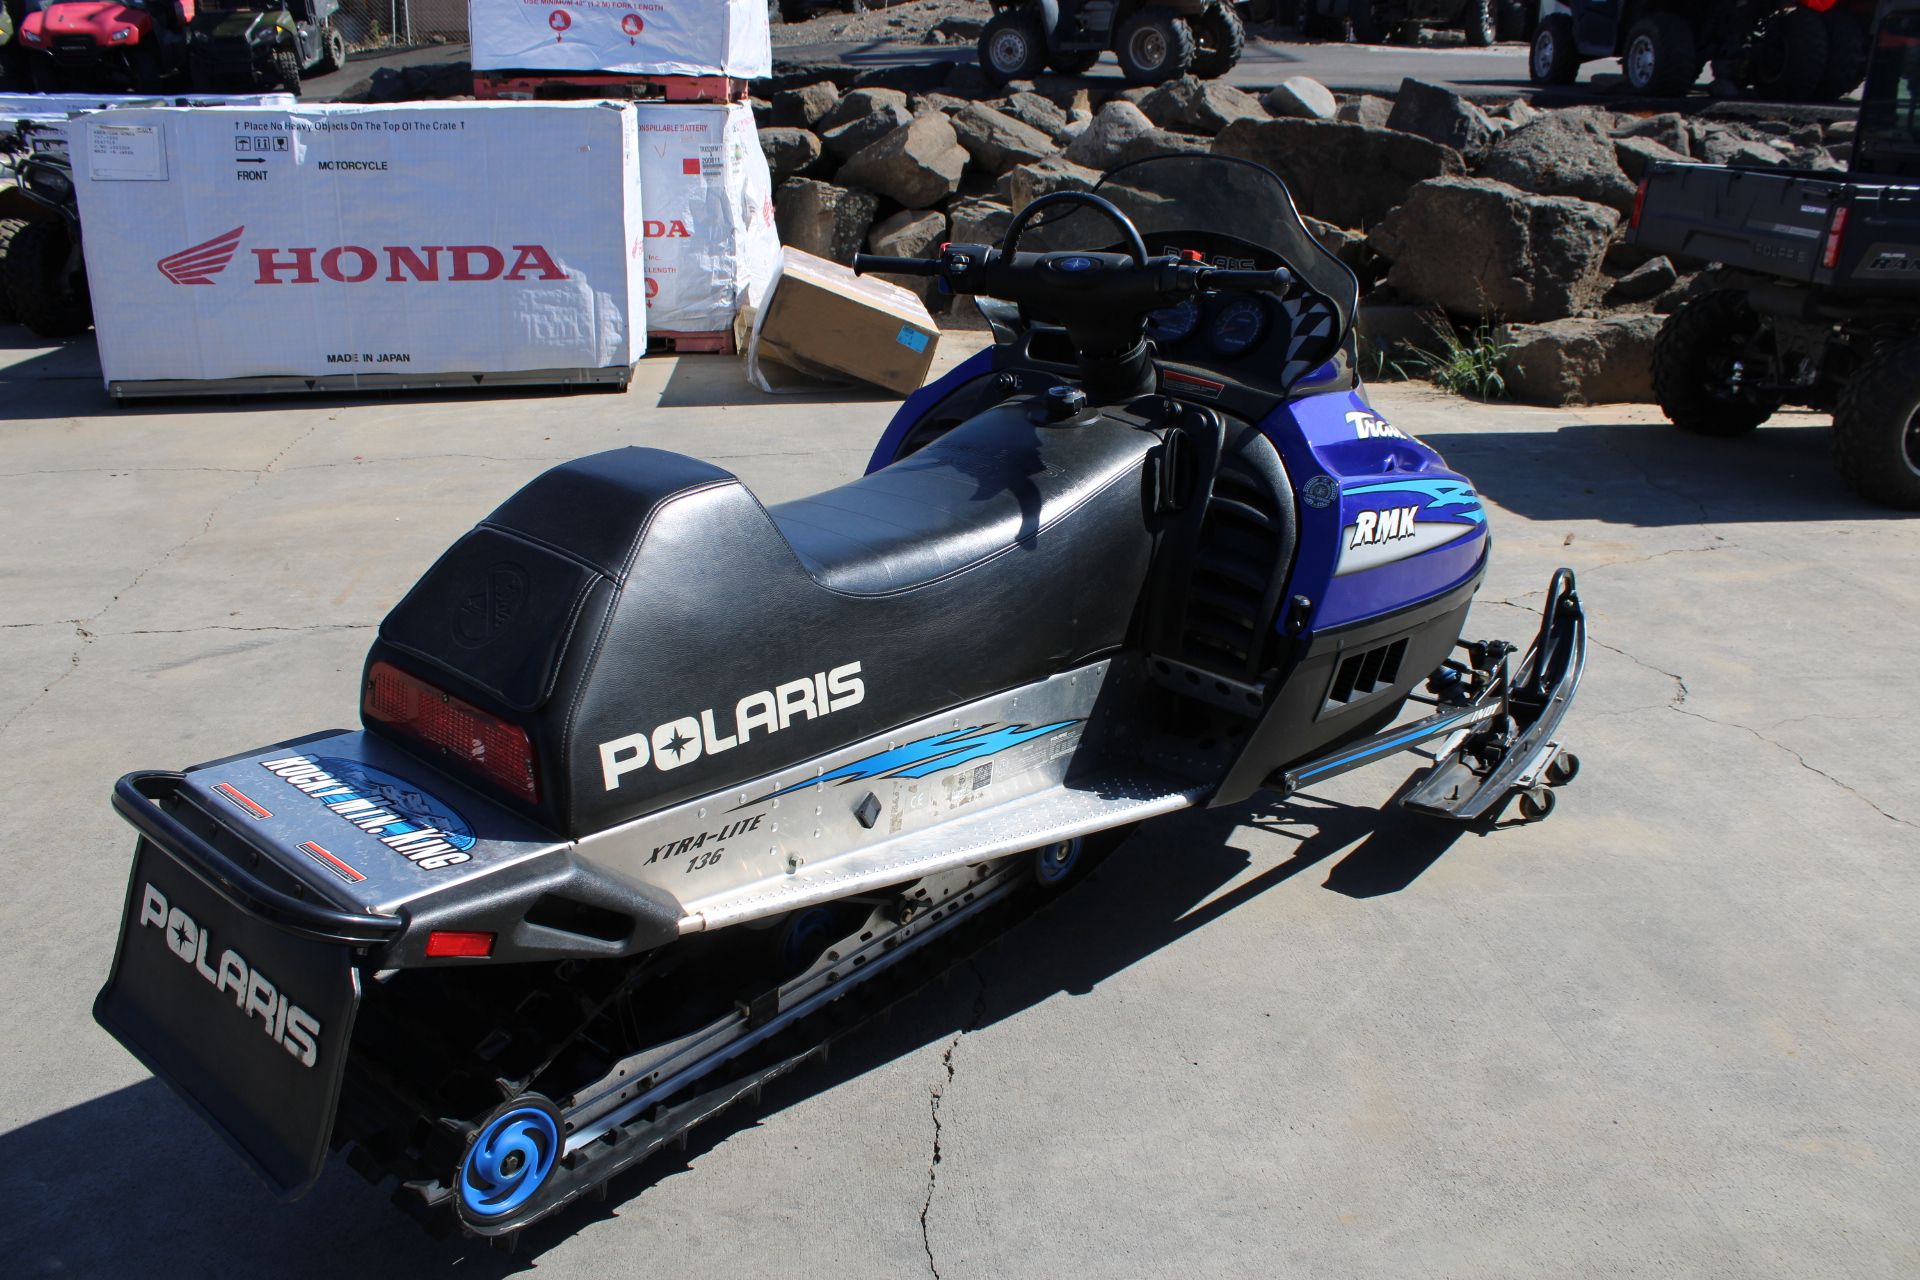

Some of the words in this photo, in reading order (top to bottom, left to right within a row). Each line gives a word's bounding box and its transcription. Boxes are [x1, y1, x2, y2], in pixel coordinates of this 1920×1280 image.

[634, 3, 664, 11] LENGTH
[244, 121, 268, 130] Place
[270, 121, 282, 131] No
[284, 121, 311, 133] Heavy
[314, 121, 349, 132] Objects
[350, 121, 363, 131] On
[365, 121, 381, 131] The
[383, 121, 400, 132] Top
[402, 122, 412, 131] Of
[414, 121, 430, 130] The
[433, 121, 457, 130] Crate
[680, 123, 708, 133] BATTERY
[237, 170, 268, 180] FRONT
[317, 161, 388, 171] MOTORCYCLE
[251, 244, 570, 284] HONDA
[327, 353, 359, 363] MADE
[362, 353, 374, 363] IN
[376, 353, 411, 363] JAPAN
[1350, 505, 1419, 550] RMK
[599, 661, 865, 791] POLARIS
[259, 754, 354, 798] ROCKY
[377, 825, 474, 870] KING
[643, 813, 767, 866] XTRA-LITE
[685, 847, 724, 874] 136
[140, 882, 321, 1068] POLARIS
